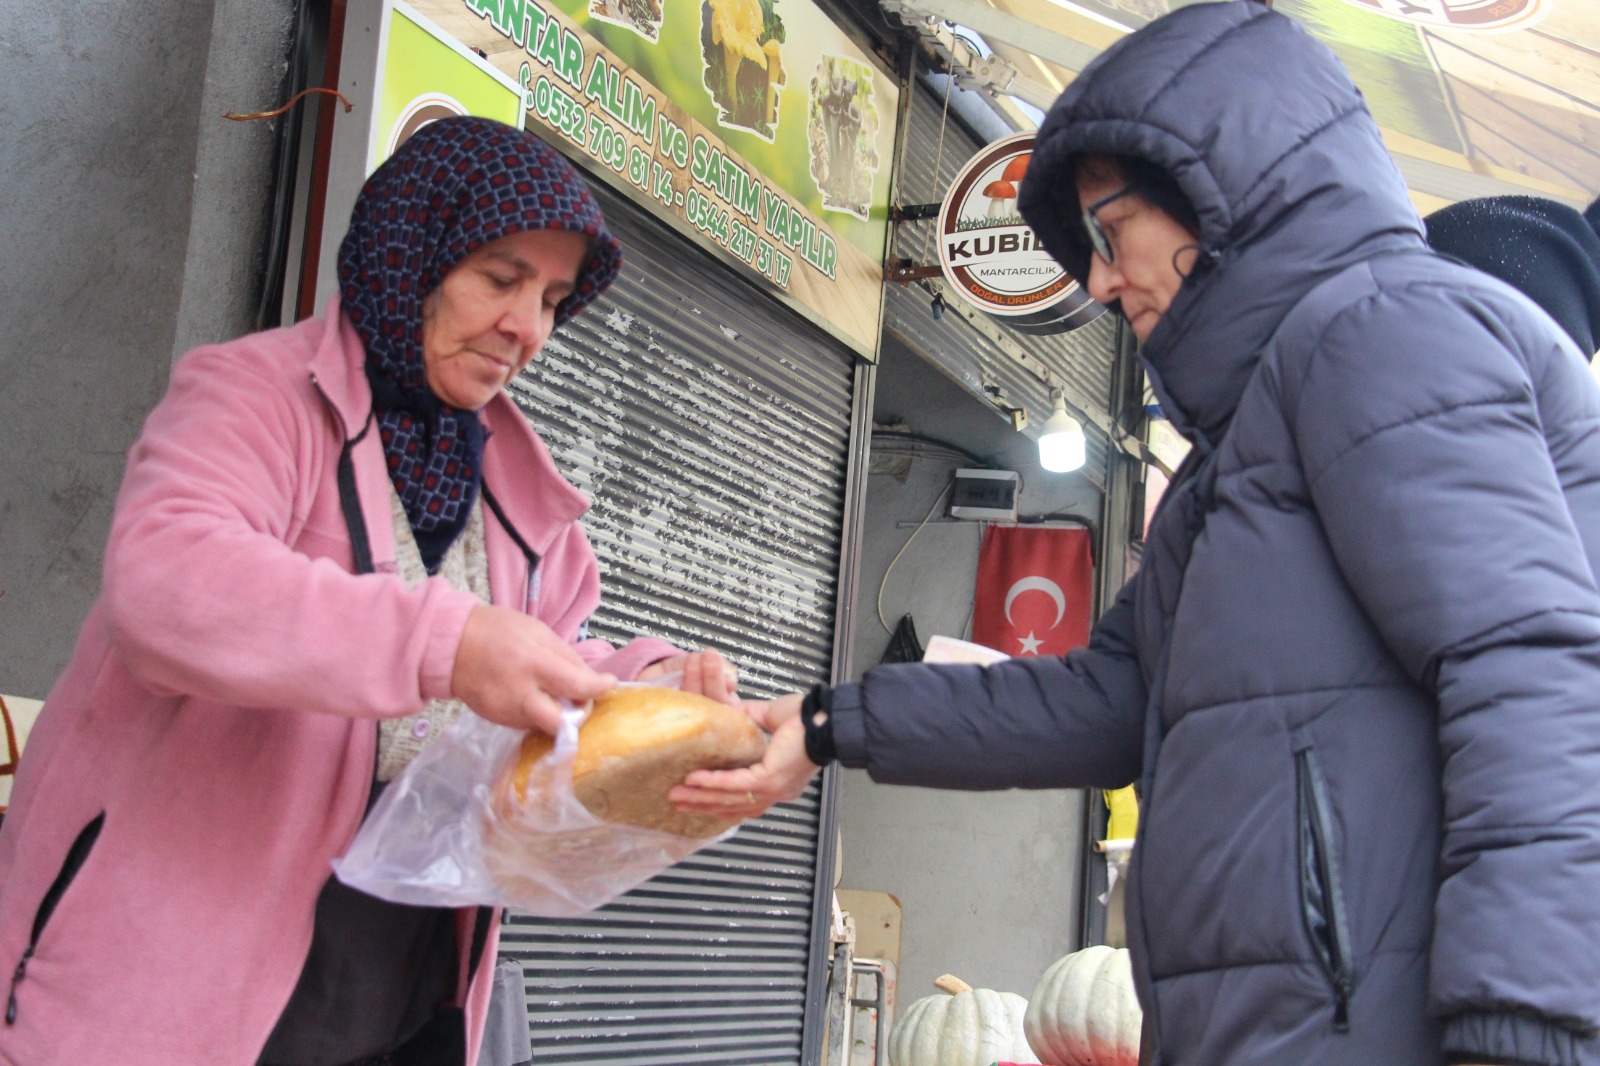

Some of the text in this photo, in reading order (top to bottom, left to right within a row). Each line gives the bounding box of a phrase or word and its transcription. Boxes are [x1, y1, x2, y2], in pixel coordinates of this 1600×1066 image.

[465, 0, 837, 282] ANTAR ALIM ve SATIM YAPILIR
[535, 77, 587, 146] 0532
[589, 113, 627, 172] 709
[629, 145, 650, 191] 81
[653, 161, 673, 207] 14
[686, 188, 729, 246] 0544
[730, 219, 758, 264] 217
[757, 238, 774, 278] 31
[776, 250, 792, 288] 17
[969, 282, 1064, 305] DOĞAL ÜRÜNLER
[980, 267, 1057, 277] MANTARCILIK
